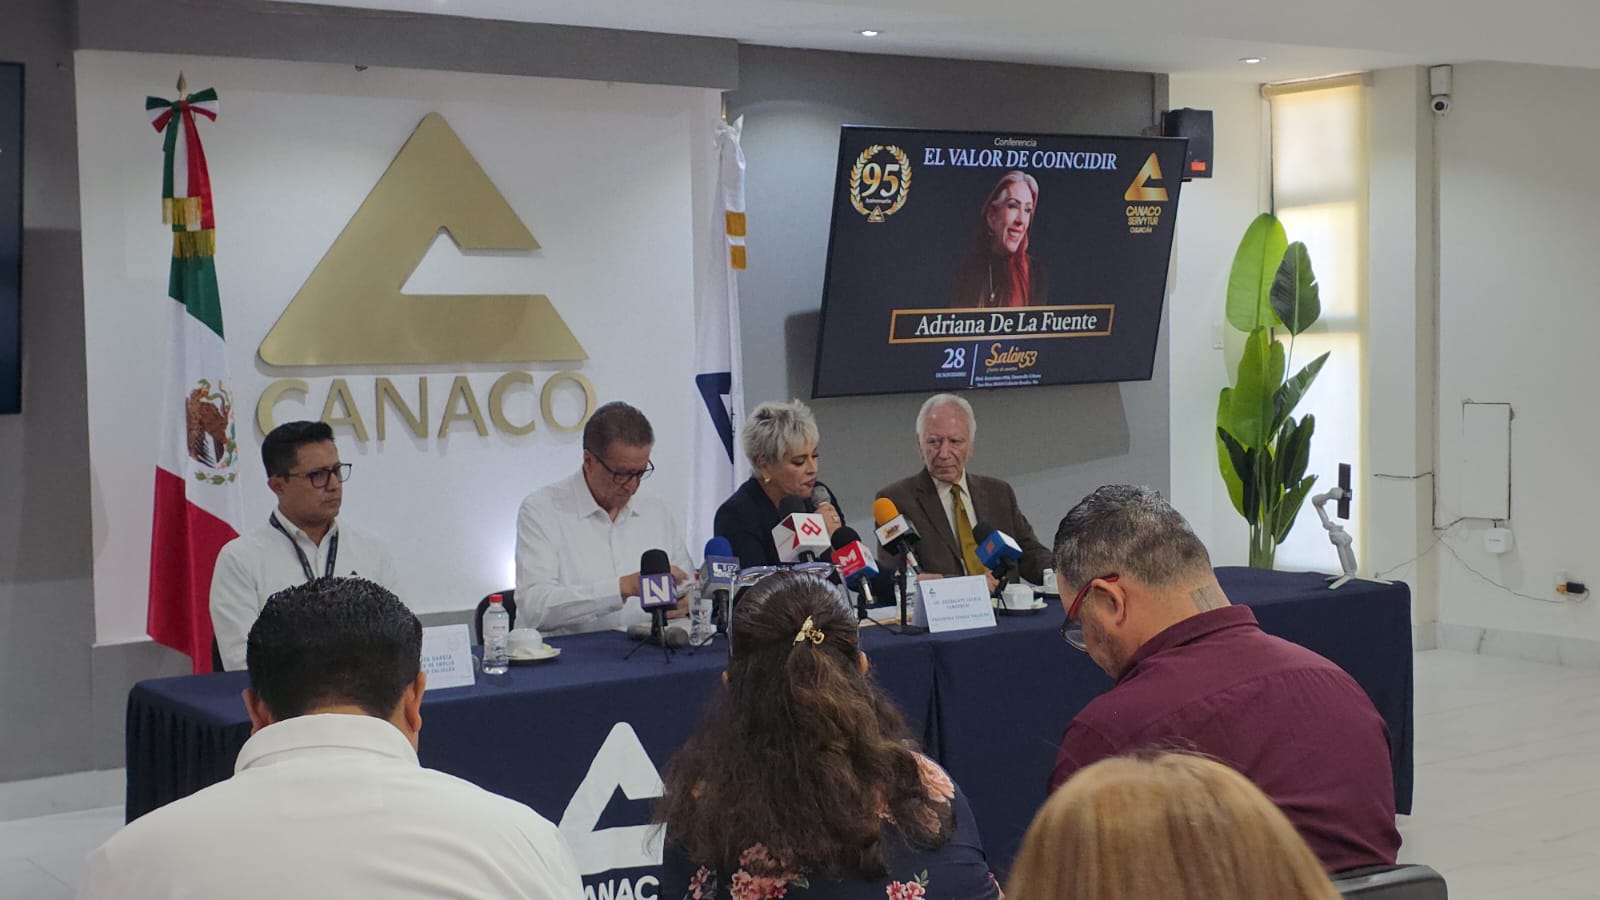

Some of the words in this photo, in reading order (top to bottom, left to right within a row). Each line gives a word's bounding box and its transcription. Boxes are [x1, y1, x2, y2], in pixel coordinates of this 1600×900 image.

[994, 137, 1037, 147] Conferencia
[923, 147, 945, 166] EL
[949, 148, 1003, 167] VALOR
[1006, 150, 1029, 168] DE
[1032, 151, 1117, 170] COINCIDIR
[861, 162, 900, 197] 95
[1126, 205, 1161, 217] CANACO
[915, 314, 985, 336] Adriana
[989, 313, 1013, 333] De
[1016, 313, 1037, 332] La
[1041, 311, 1098, 331] Fuente
[941, 347, 966, 369] 28
[256, 370, 598, 442] CANACO
[582, 875, 660, 900] ANAC
